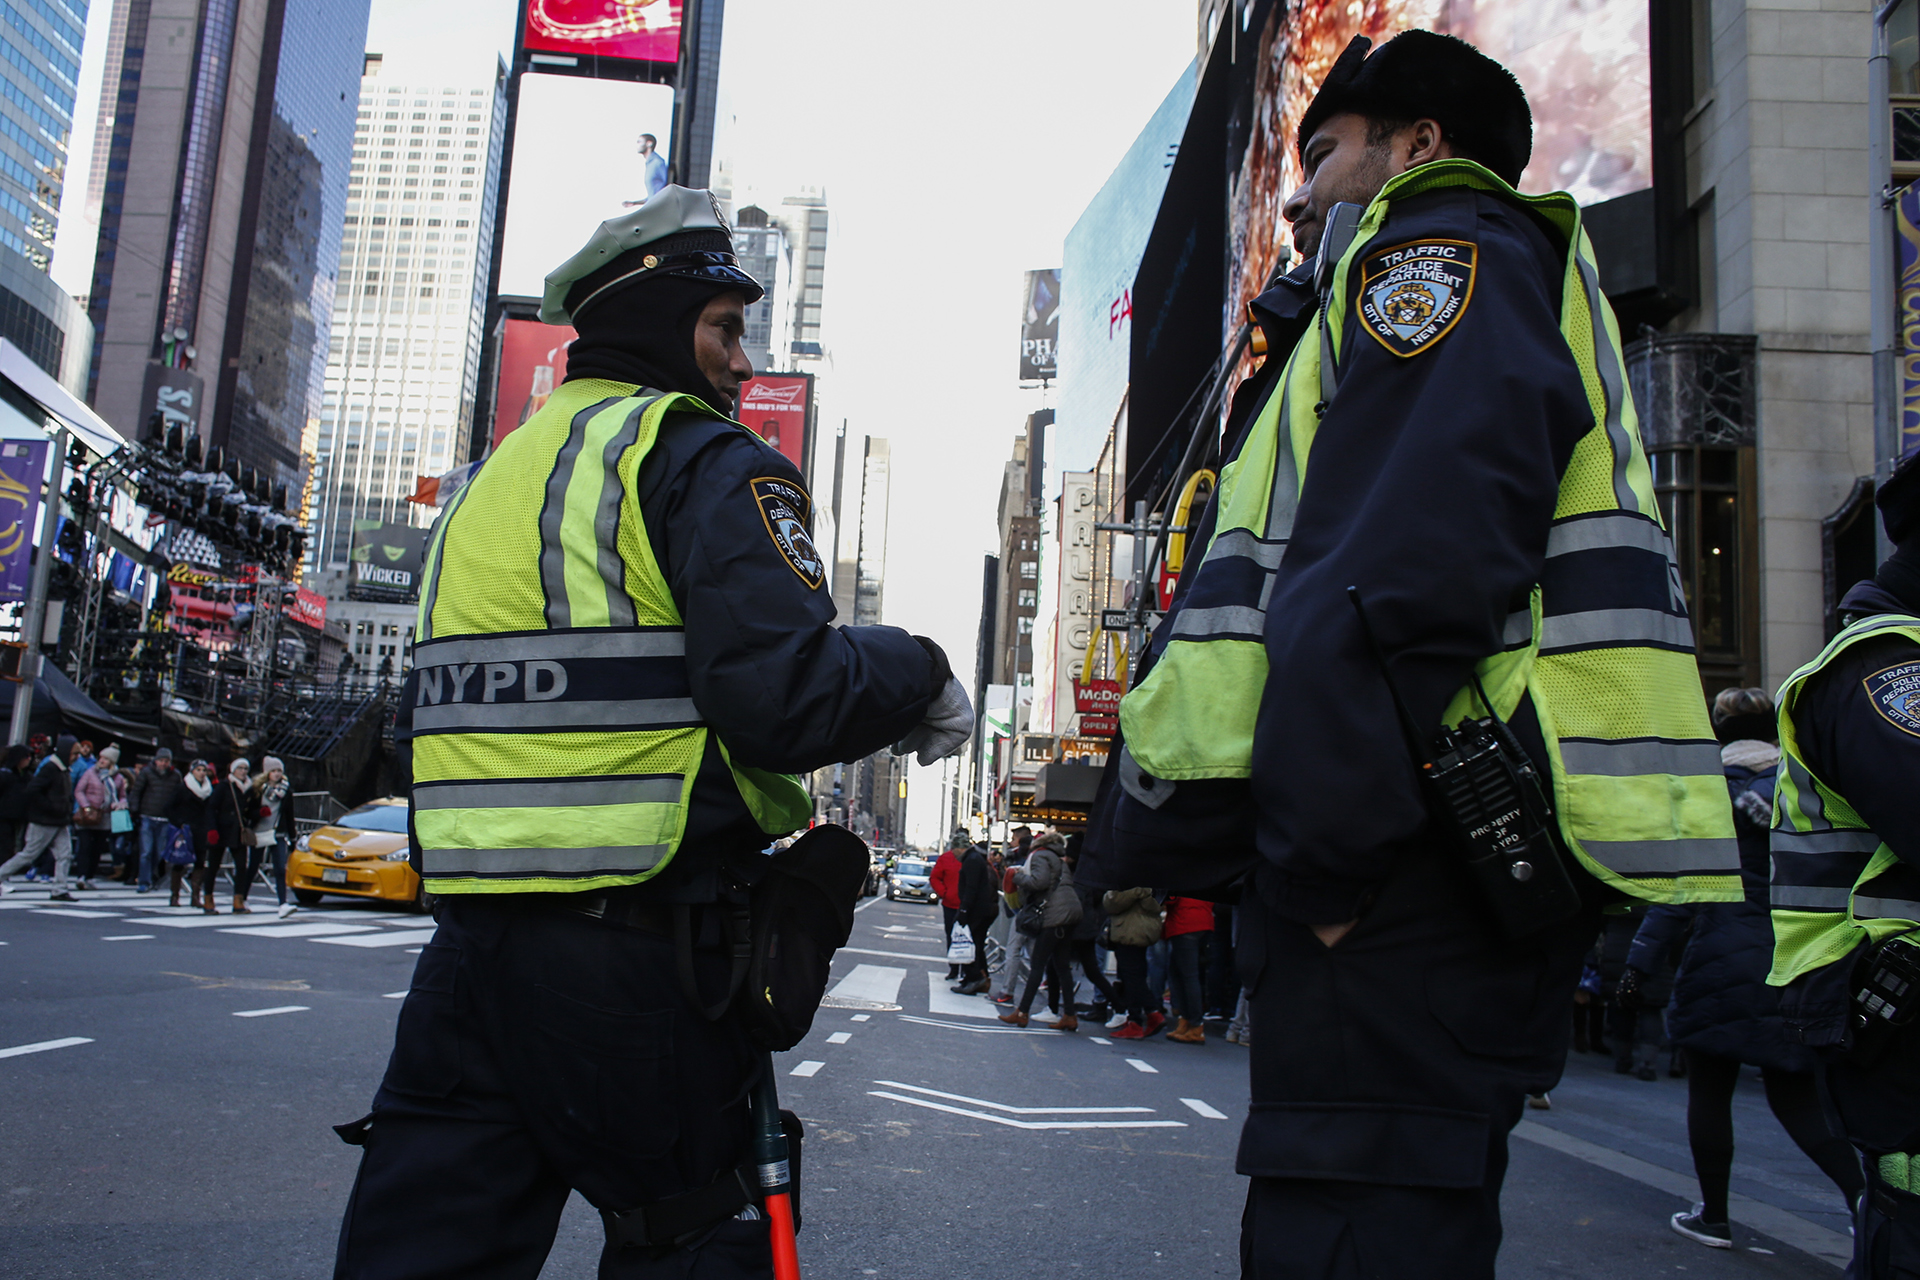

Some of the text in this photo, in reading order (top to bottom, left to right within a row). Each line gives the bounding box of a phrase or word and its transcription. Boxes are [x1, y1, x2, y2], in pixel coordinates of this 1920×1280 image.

[1380, 246, 1457, 267] TRAFFIC
[1389, 261, 1443, 277] POLICE
[1367, 270, 1463, 296] DEPARTMENT
[1364, 303, 1394, 337] CITY OF
[1410, 295, 1461, 346] NEW YORK
[1031, 355, 1048, 366] OF
[751, 387, 798, 398] Budweiser
[742, 402, 756, 411] THIS
[757, 403, 775, 411] BUD'S
[766, 483, 801, 507] TRAFFIC
[776, 533, 794, 556] CITY
[793, 558, 805, 571] OF
[1109, 616, 1128, 627] ONE
[417, 660, 568, 706] NYPD
[1079, 689, 1121, 702] McDo
[1882, 682, 1920, 704] DEPART
[1083, 722, 1108, 731] OPEN
[1888, 709, 1920, 728] CITY OF
[1027, 748, 1052, 760] ILL
[1077, 742, 1096, 750] THE
